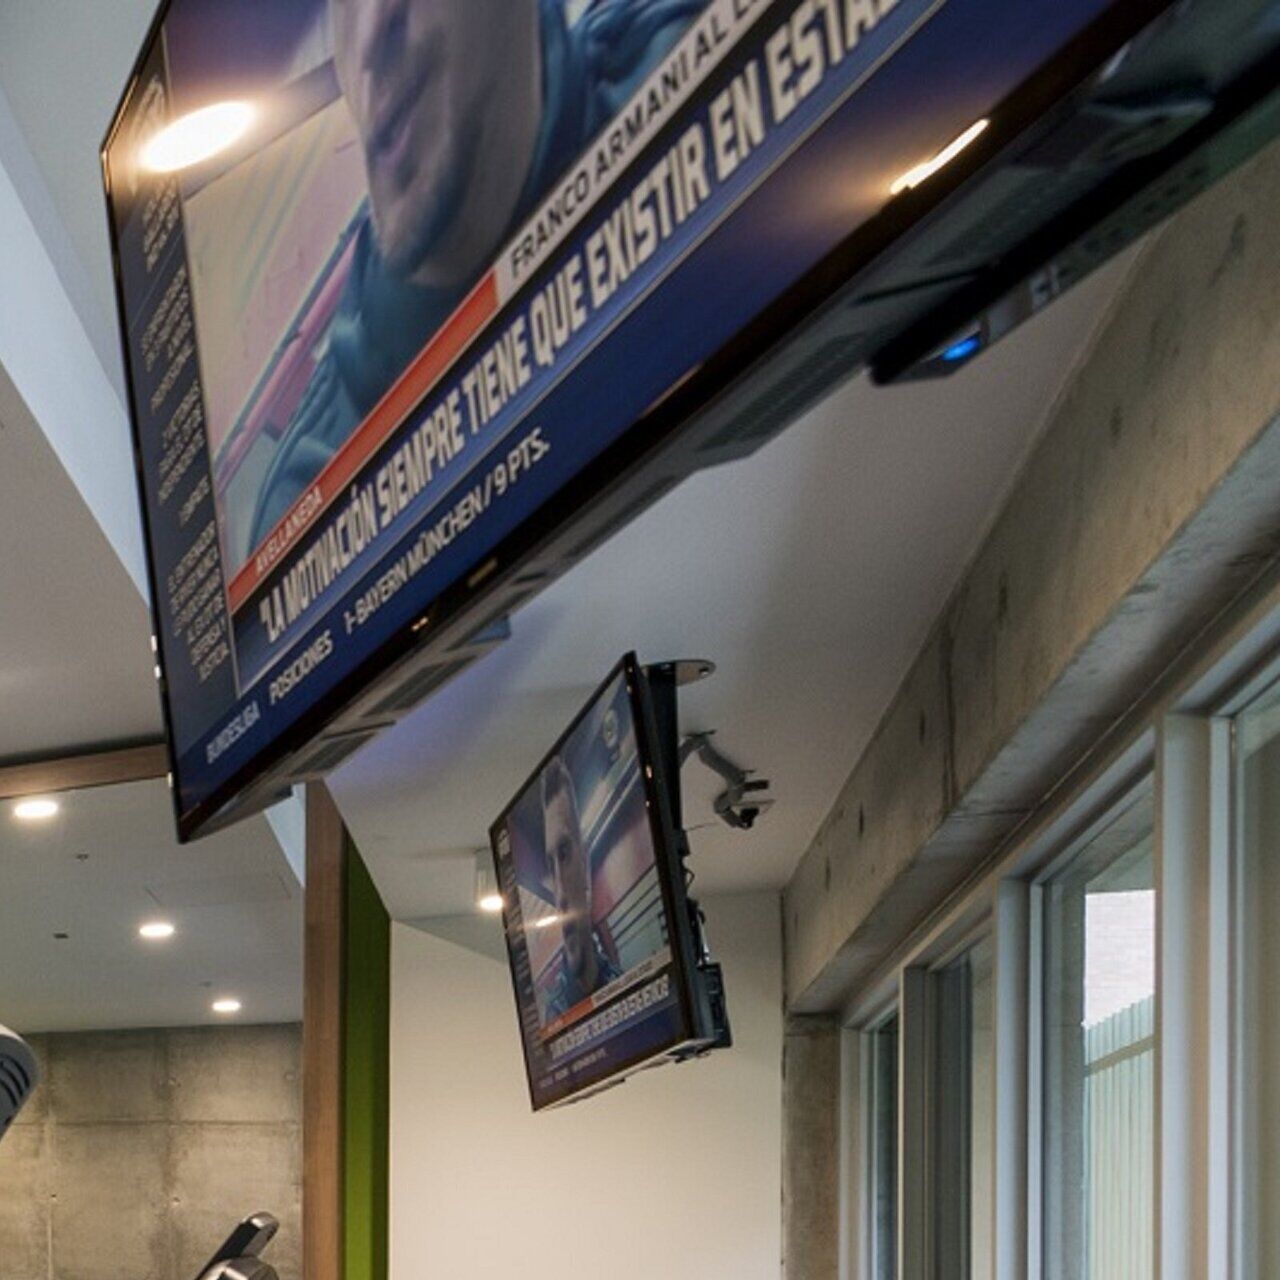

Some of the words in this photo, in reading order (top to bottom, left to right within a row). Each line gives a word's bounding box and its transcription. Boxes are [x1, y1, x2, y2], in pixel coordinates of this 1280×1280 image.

[510, 169, 590, 277] FRANCO
[596, 51, 689, 183] ARMANI
[694, 13, 729, 69] AL
[281, 483, 378, 619] MOTIVACIÓN
[376, 388, 465, 528] SIEMPRE
[462, 313, 531, 434] TIENE
[530, 254, 587, 366] QUE
[585, 122, 711, 309] EXISTIR
[709, 60, 765, 182] EN
[764, 0, 898, 124] ESTA
[255, 486, 324, 576] AVELLANEDA
[269, 629, 334, 706] POSICIONES
